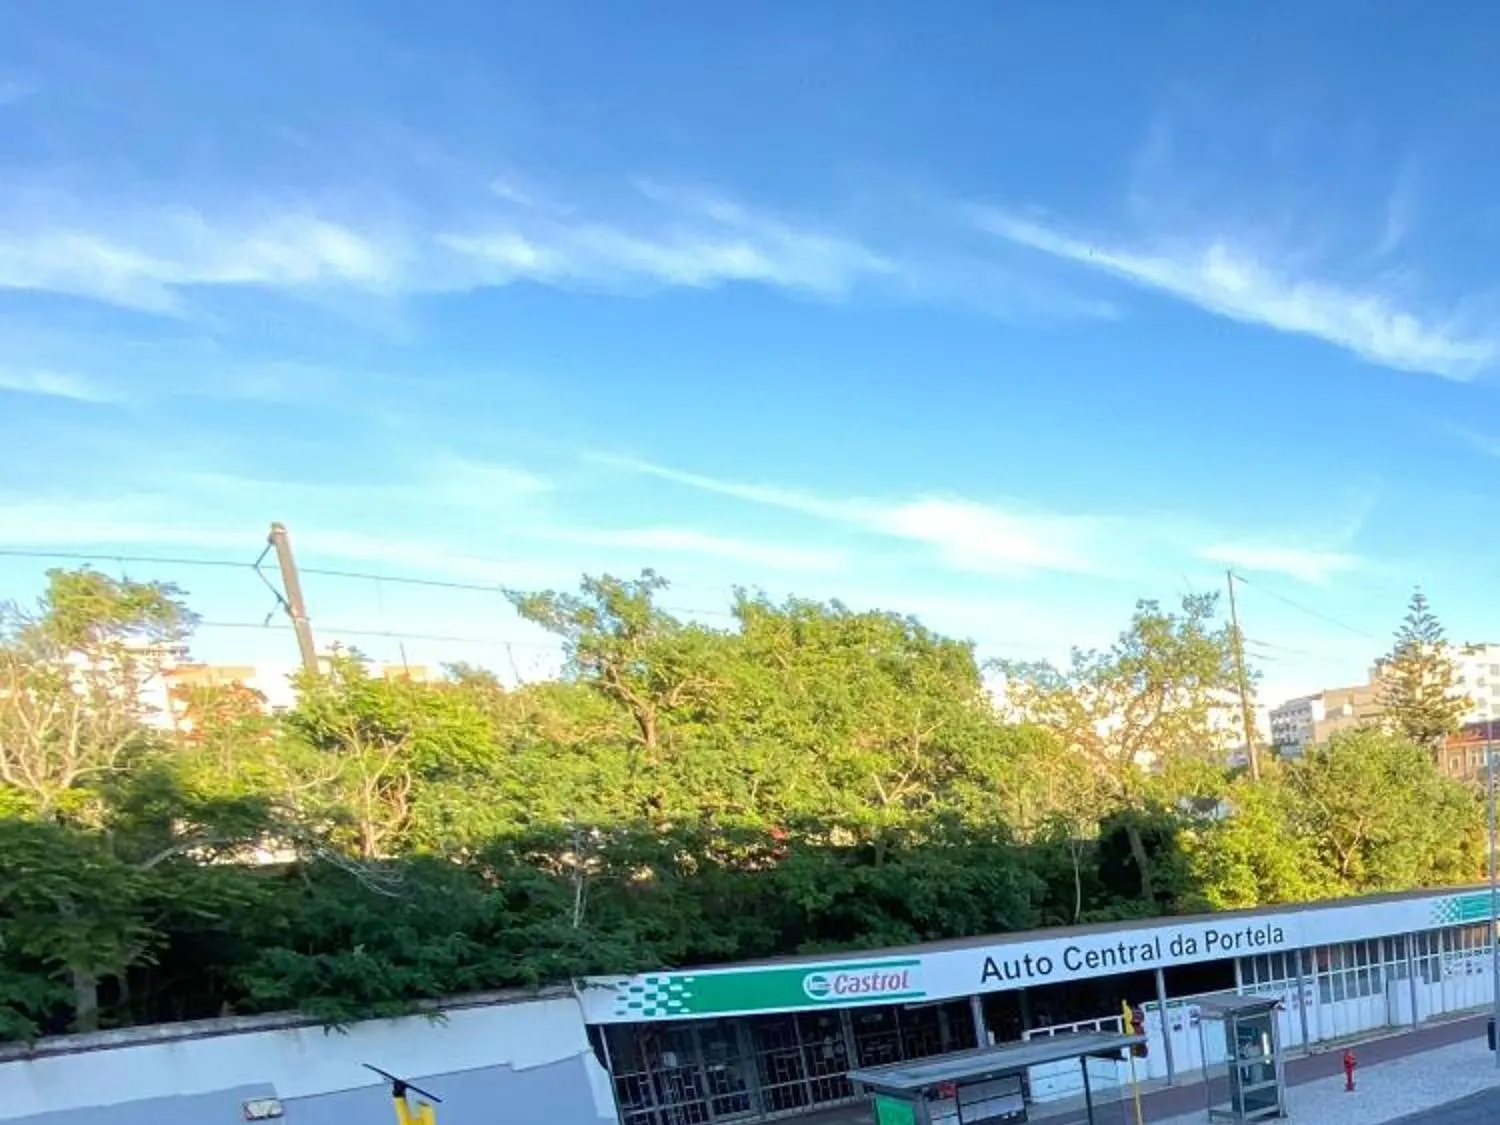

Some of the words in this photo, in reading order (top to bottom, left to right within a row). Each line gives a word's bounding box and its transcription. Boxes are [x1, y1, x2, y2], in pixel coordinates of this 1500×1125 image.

[980, 955, 1053, 984] Auto
[1063, 936, 1161, 971] Central
[1170, 932, 1198, 958] da
[1205, 923, 1284, 953] Portela
[834, 970, 909, 994] Castrol
